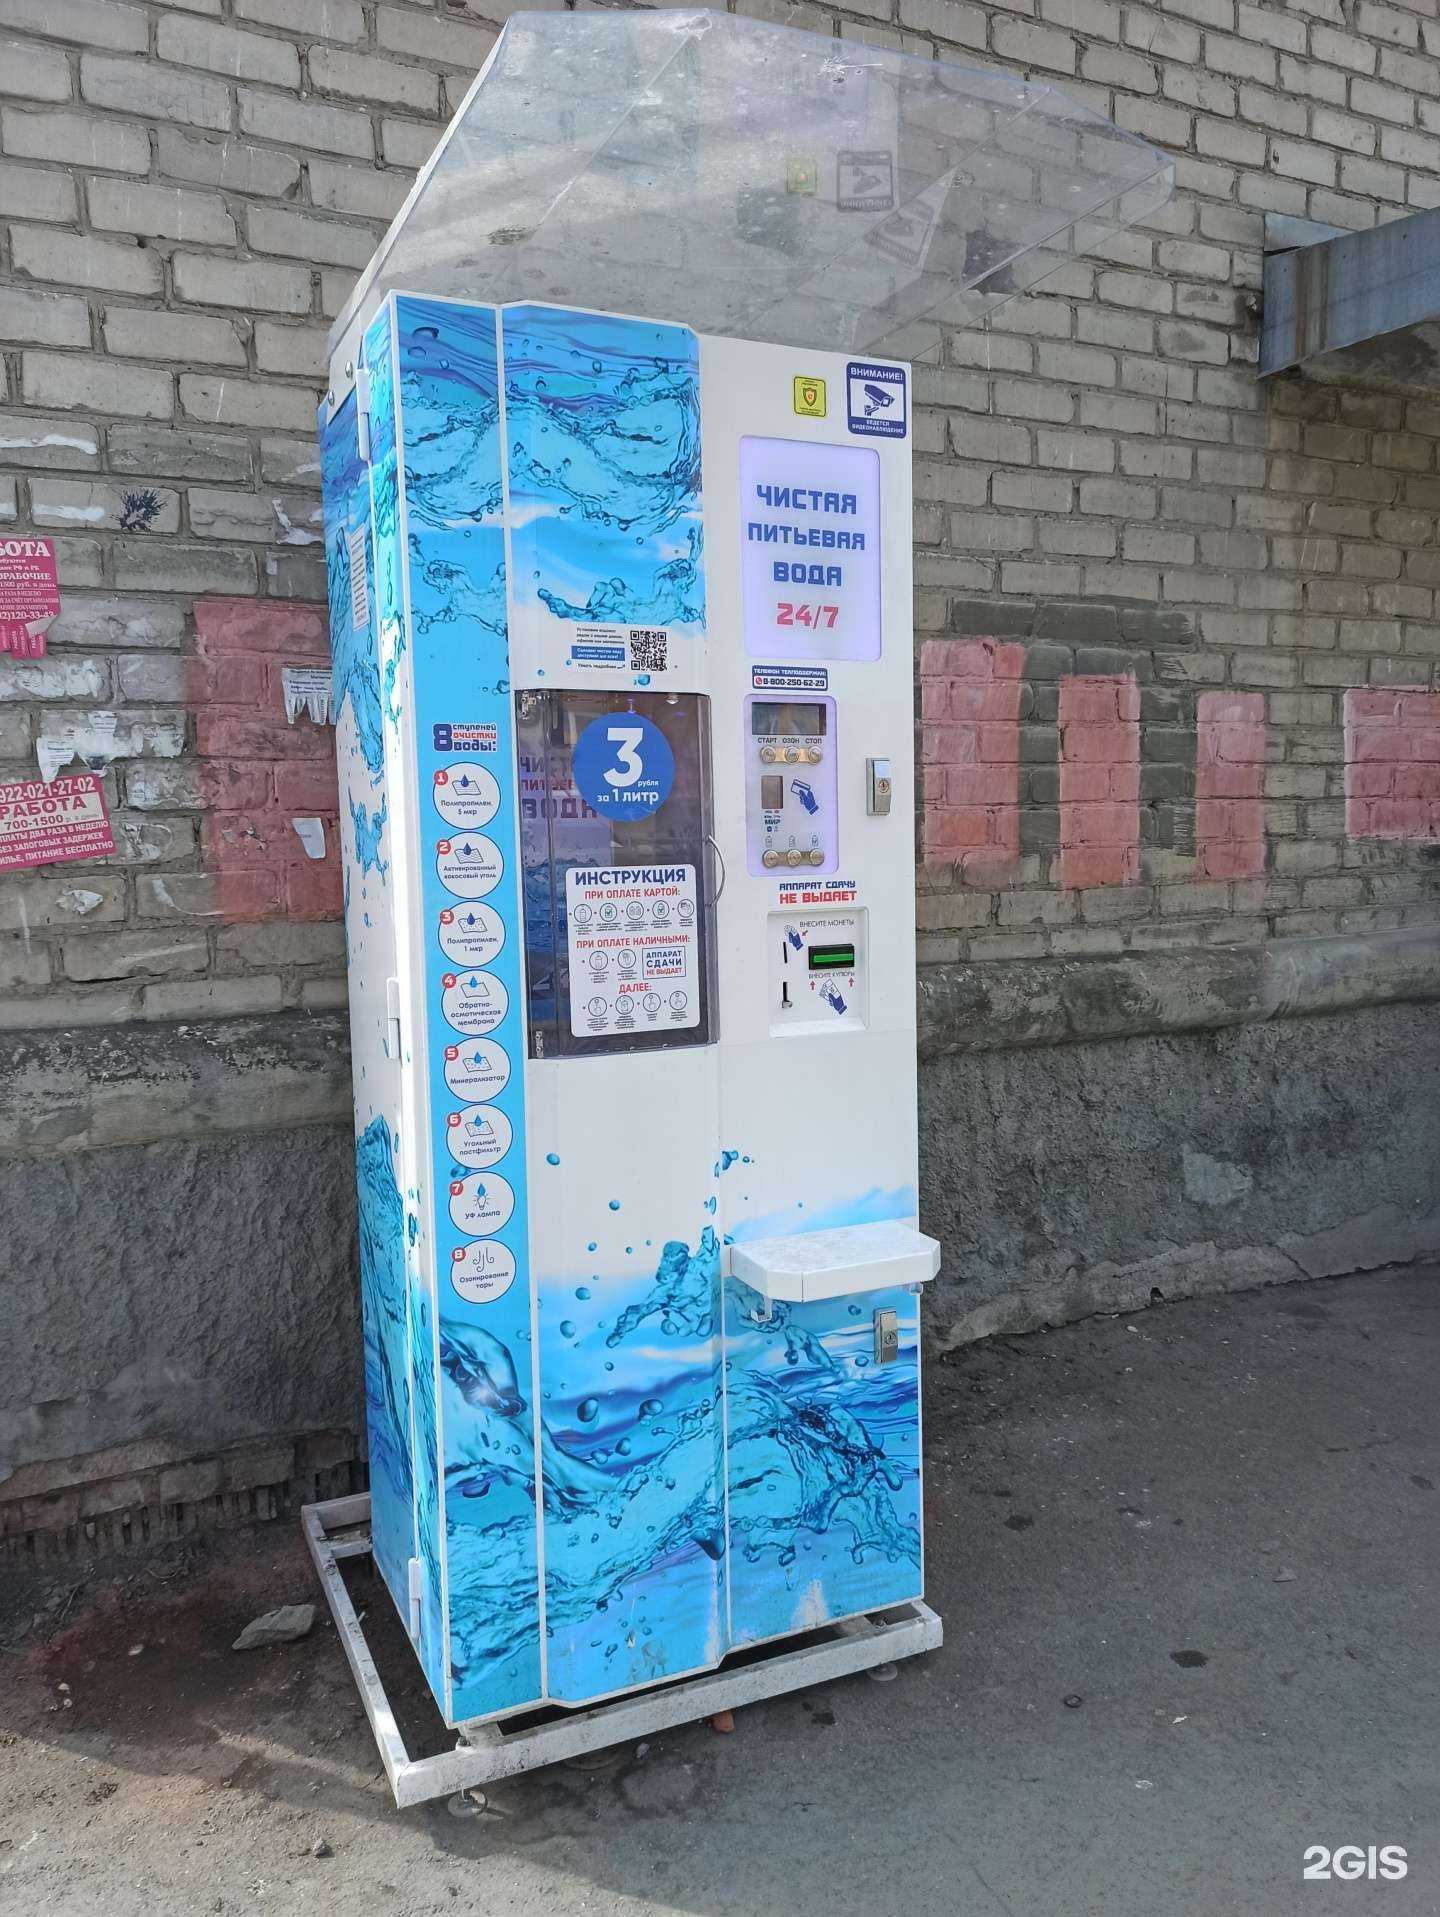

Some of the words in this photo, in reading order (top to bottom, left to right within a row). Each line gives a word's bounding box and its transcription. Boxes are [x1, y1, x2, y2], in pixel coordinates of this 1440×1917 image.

[850, 367, 904, 381] ВНИМАНИЕ!
[756, 484, 857, 515] ЧИСТАЯ
[748, 522, 866, 551] ПИТЬЕВАЯ
[773, 561, 842, 587] ВОДА
[776, 602, 839, 630] 24/7
[453, 724, 497, 732] ступеней
[433, 723, 453, 751] 8
[453, 731, 497, 739] очистки
[453, 739, 497, 751] воды:
[603, 727, 644, 787] 3
[637, 779, 659, 787] рубля
[597, 794, 610, 802] за
[612, 789, 619, 801] 1
[621, 790, 660, 804] литр
[4, 815, 64, 831] 700-1500
[29, 829, 46, 840] ДВА
[47, 826, 67, 836] РАЗА
[68, 825, 74, 833] В
[75, 820, 109, 832] НЕДЕЛЮ
[62, 832, 104, 845] ЗАДЕРЖЕК
[25, 849, 65, 861] ПИТАНИЕ
[65, 841, 114, 856] БЕСПЛАТНО
[439, 842, 449, 853] 2
[575, 869, 687, 886] ИНСТРУКЦИЯ
[779, 882, 822, 891] АППАРАТ
[825, 881, 856, 889] СДАЧУ
[585, 890, 604, 900] ПРИ
[607, 889, 641, 898] ОПЛАТЕ
[644, 886, 681, 897] КАРТОЙ:
[779, 893, 797, 904] НЕ
[802, 891, 857, 903] ВЫДАЕТ
[442, 911, 451, 922] 3
[576, 940, 595, 949] ПРИ
[597, 938, 631, 947] ОПЛАТЕ
[633, 935, 691, 946] НАЛИЧНЫМИ:
[646, 951, 682, 959] АППАРАТ
[646, 959, 682, 968] СДАЧИ
[444, 975, 454, 986] 4
[618, 983, 652, 994] ДАЛЕЕ:
[457, 1018, 495, 1026] мембрана
[446, 1049, 456, 1060] 5
[450, 1075, 506, 1085] Минерализатор
[449, 1114, 459, 1125] 6
[463, 1139, 497, 1148] Угольный
[459, 1146, 502, 1157] постфильтр
[452, 1182, 461, 1194] 7
[464, 1212, 476, 1220] УФ
[477, 1210, 501, 1219] лампа
[459, 1271, 509, 1283] Озонирование
[475, 1281, 494, 1290] тары
